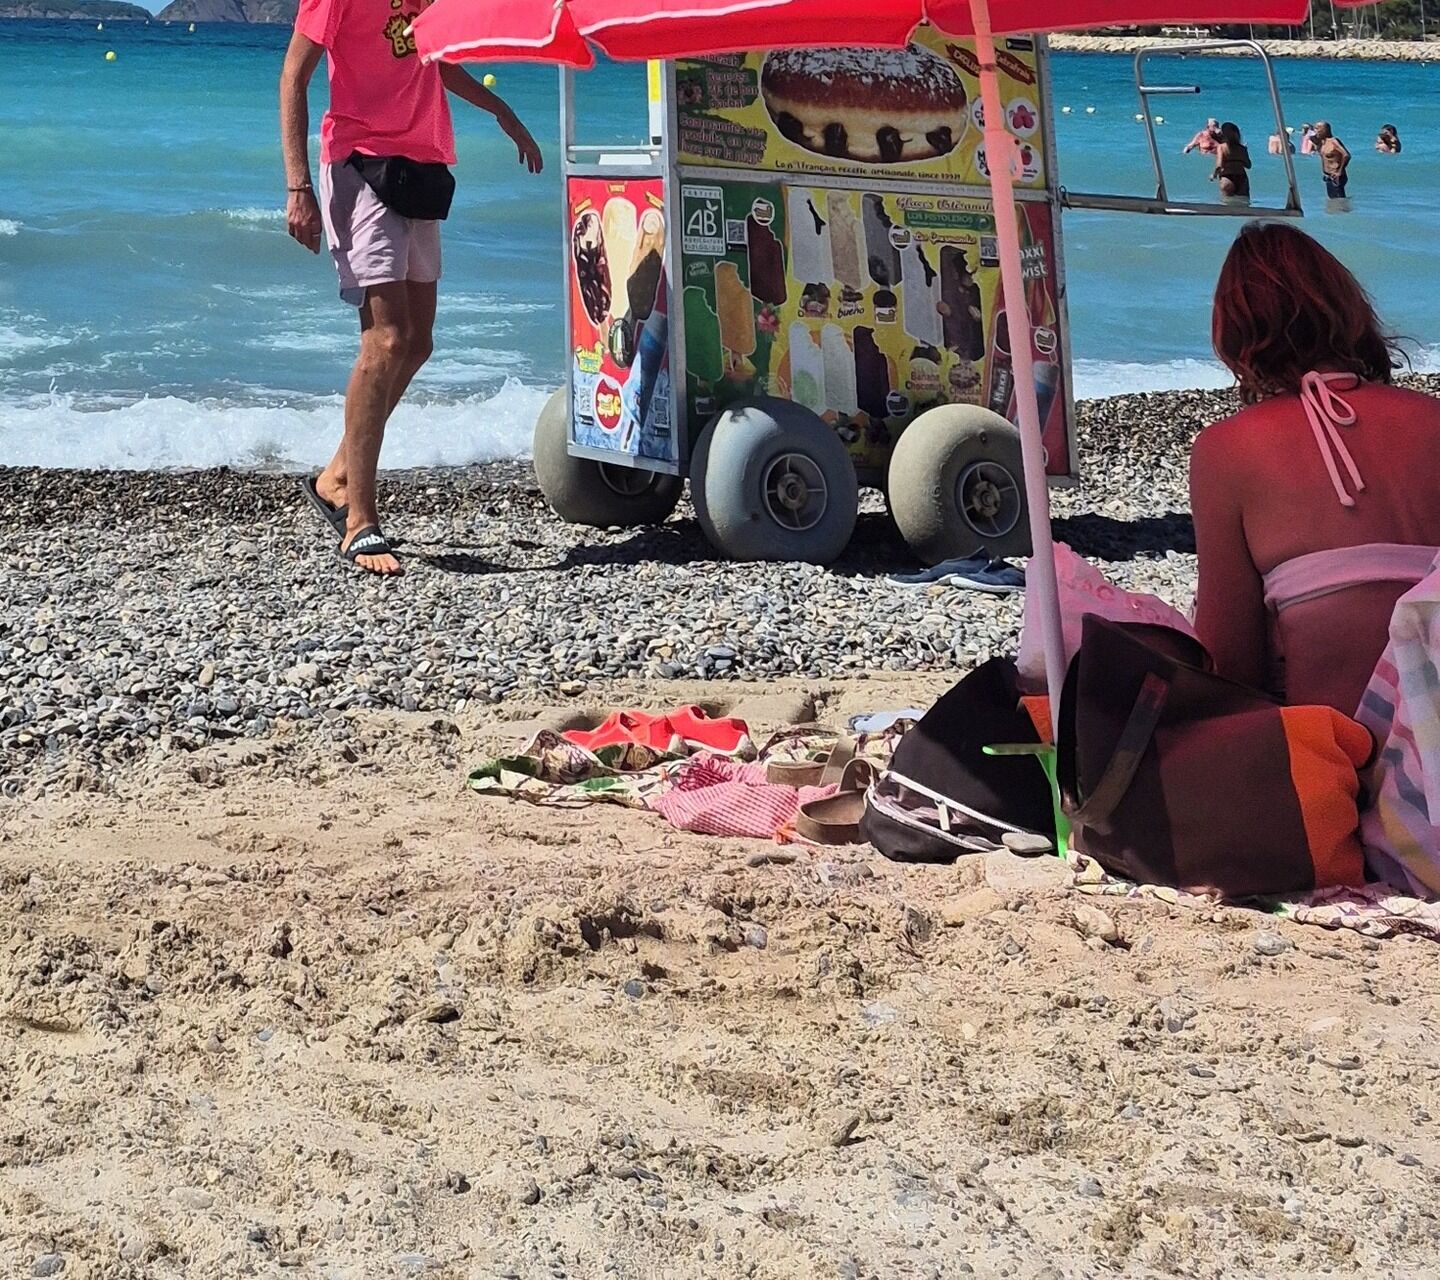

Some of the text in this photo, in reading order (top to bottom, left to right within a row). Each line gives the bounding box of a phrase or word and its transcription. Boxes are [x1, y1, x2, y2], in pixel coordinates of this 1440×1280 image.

[687, 208, 717, 236] AB
[1019, 243, 1045, 259] axxi
[1022, 261, 1048, 279] wist
[837, 307, 865, 318] bueno
